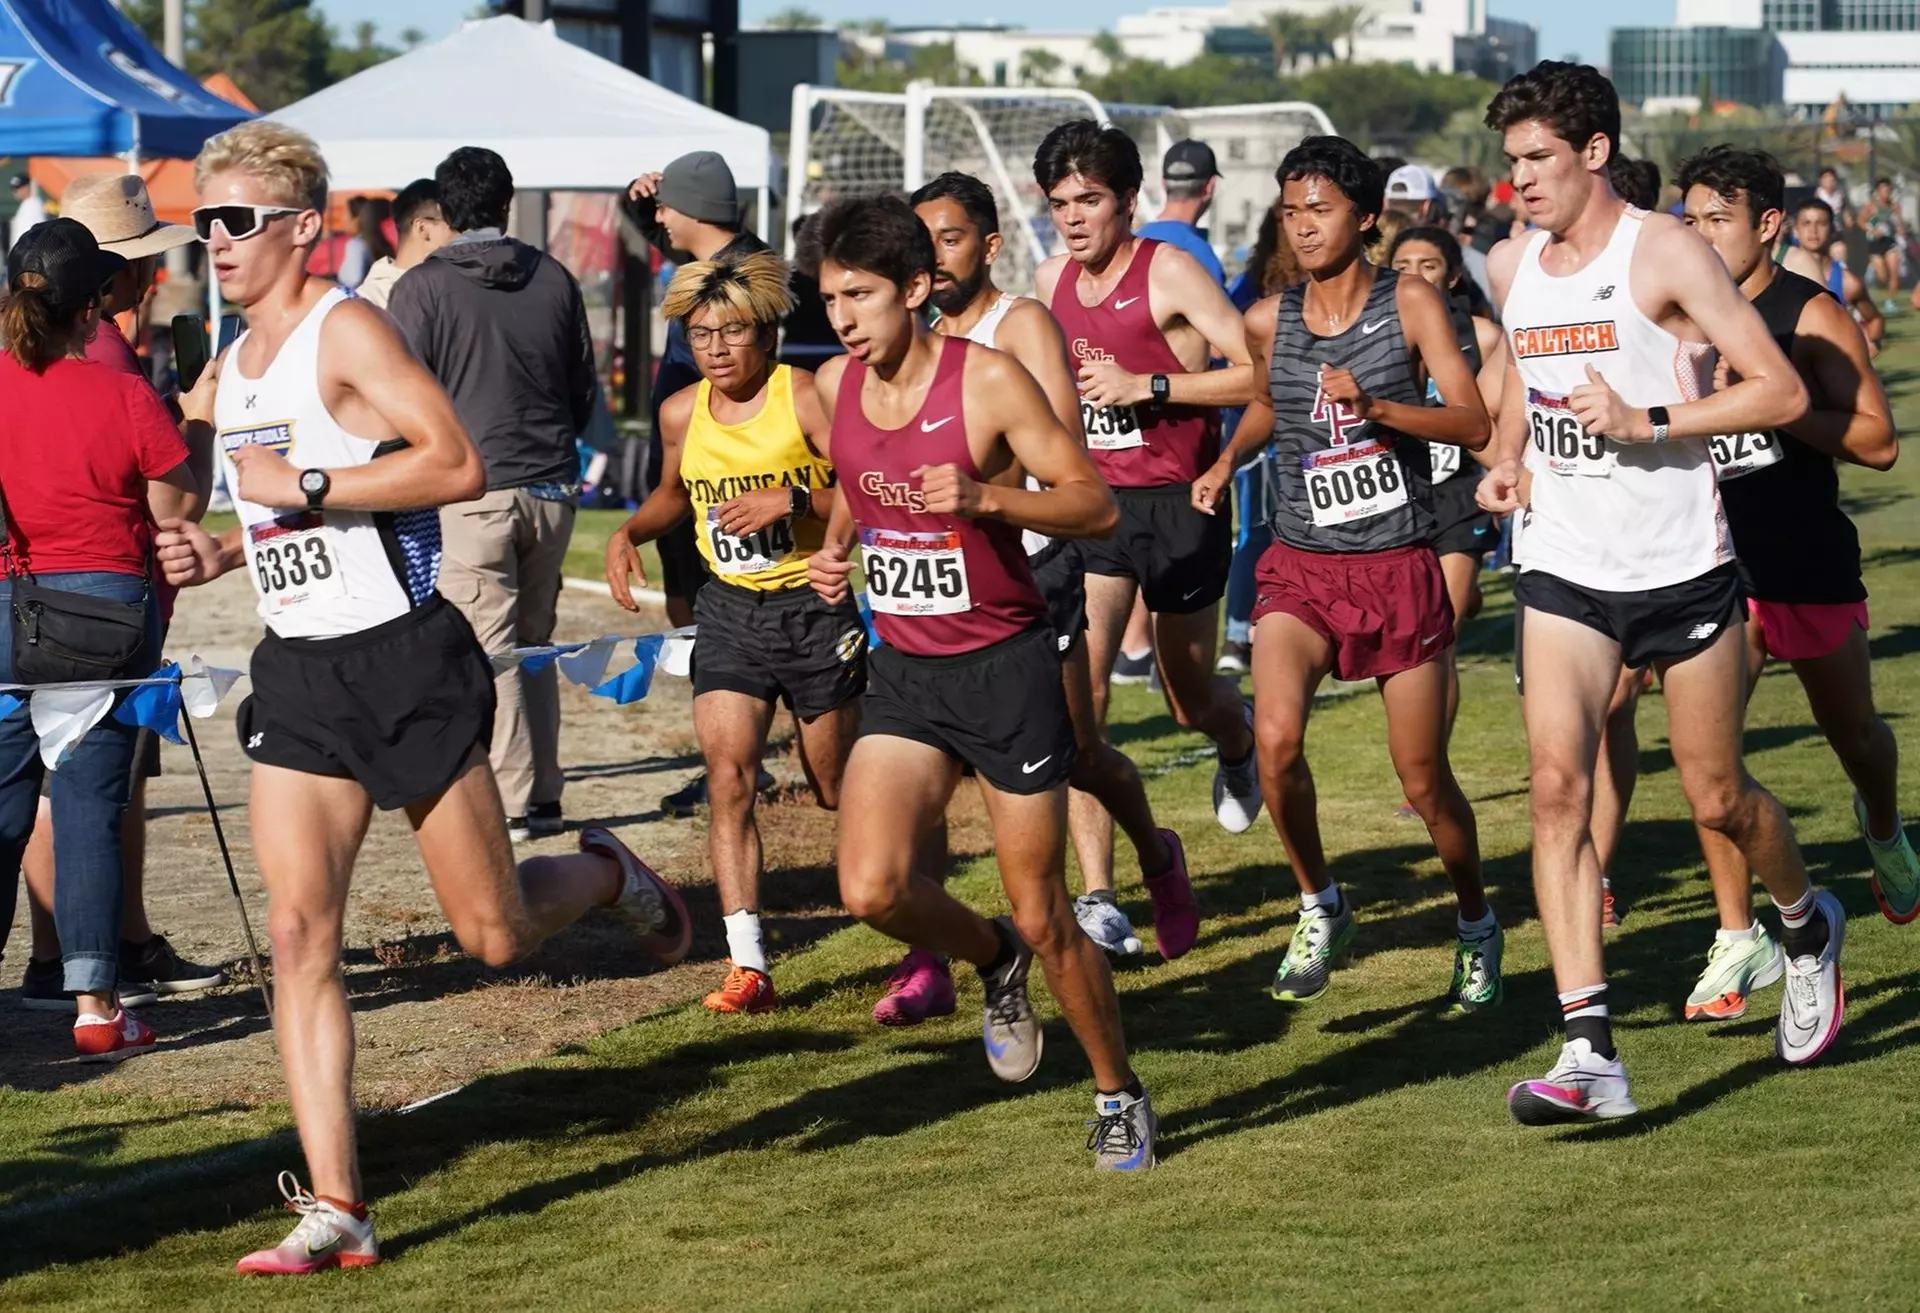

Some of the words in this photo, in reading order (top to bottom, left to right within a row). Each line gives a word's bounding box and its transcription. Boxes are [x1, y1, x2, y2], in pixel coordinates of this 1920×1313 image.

[1514, 321, 1618, 358] CALTECH
[1532, 411, 1605, 461] 6165
[859, 472, 927, 513] CMS
[1310, 457, 1399, 510] 6088
[256, 536, 333, 594] 6333
[867, 554, 963, 599] 6245
